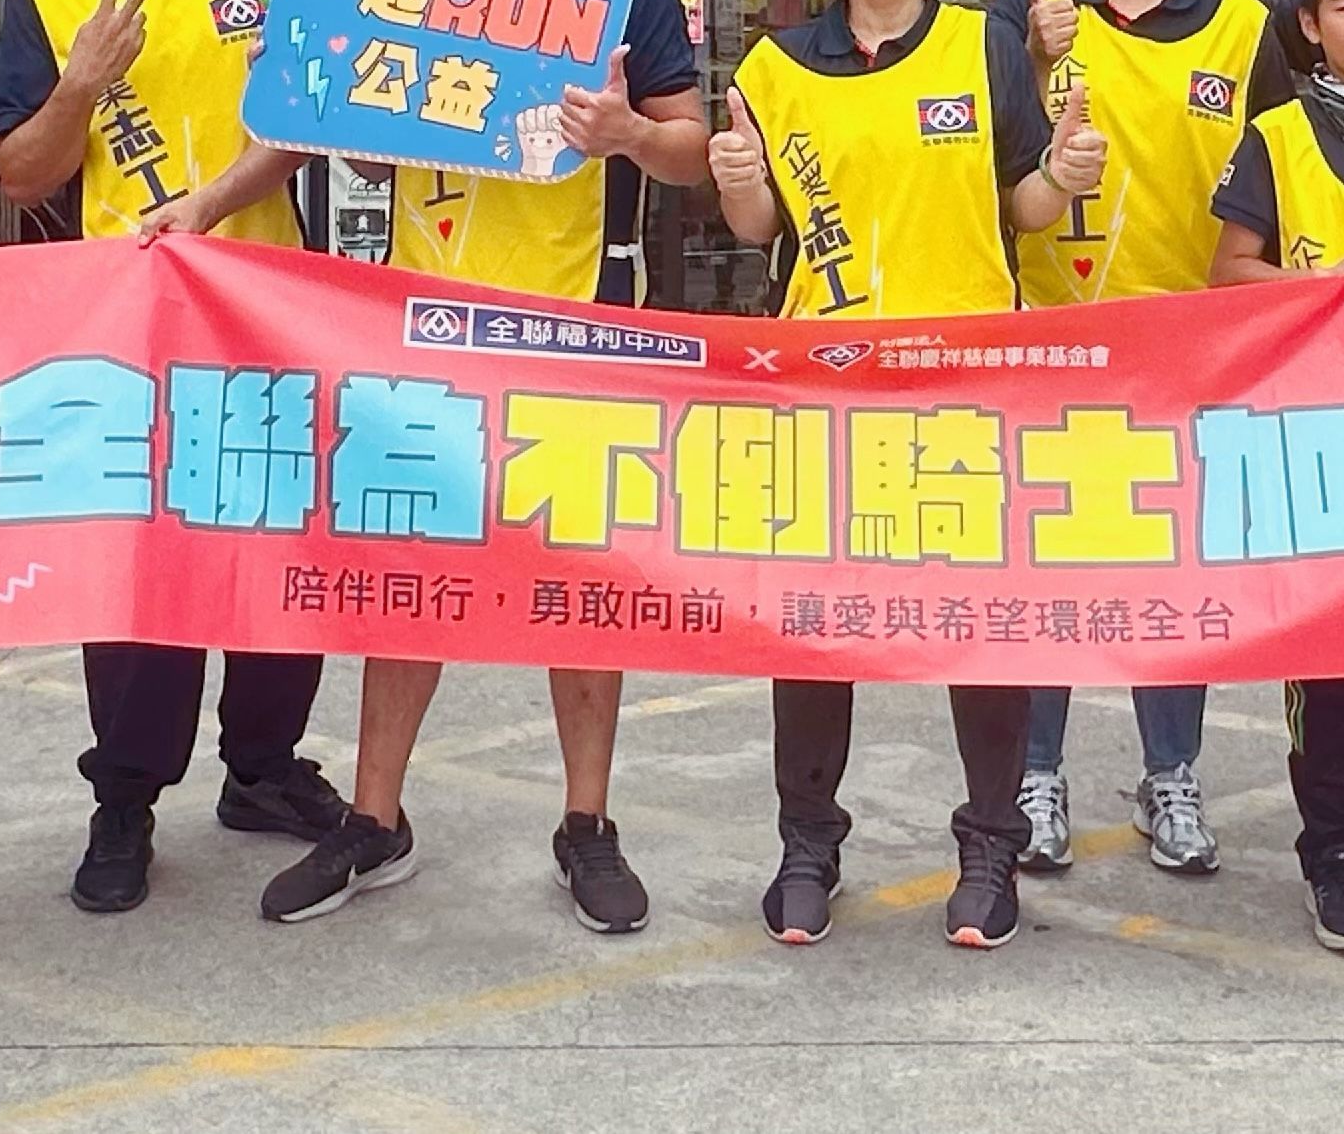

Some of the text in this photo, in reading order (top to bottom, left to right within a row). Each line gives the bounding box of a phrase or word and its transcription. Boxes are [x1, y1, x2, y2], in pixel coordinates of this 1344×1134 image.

[347, 38, 502, 135] 公益
[779, 130, 870, 316] 企業志工
[485, 315, 690, 357] 全聯福利中心
